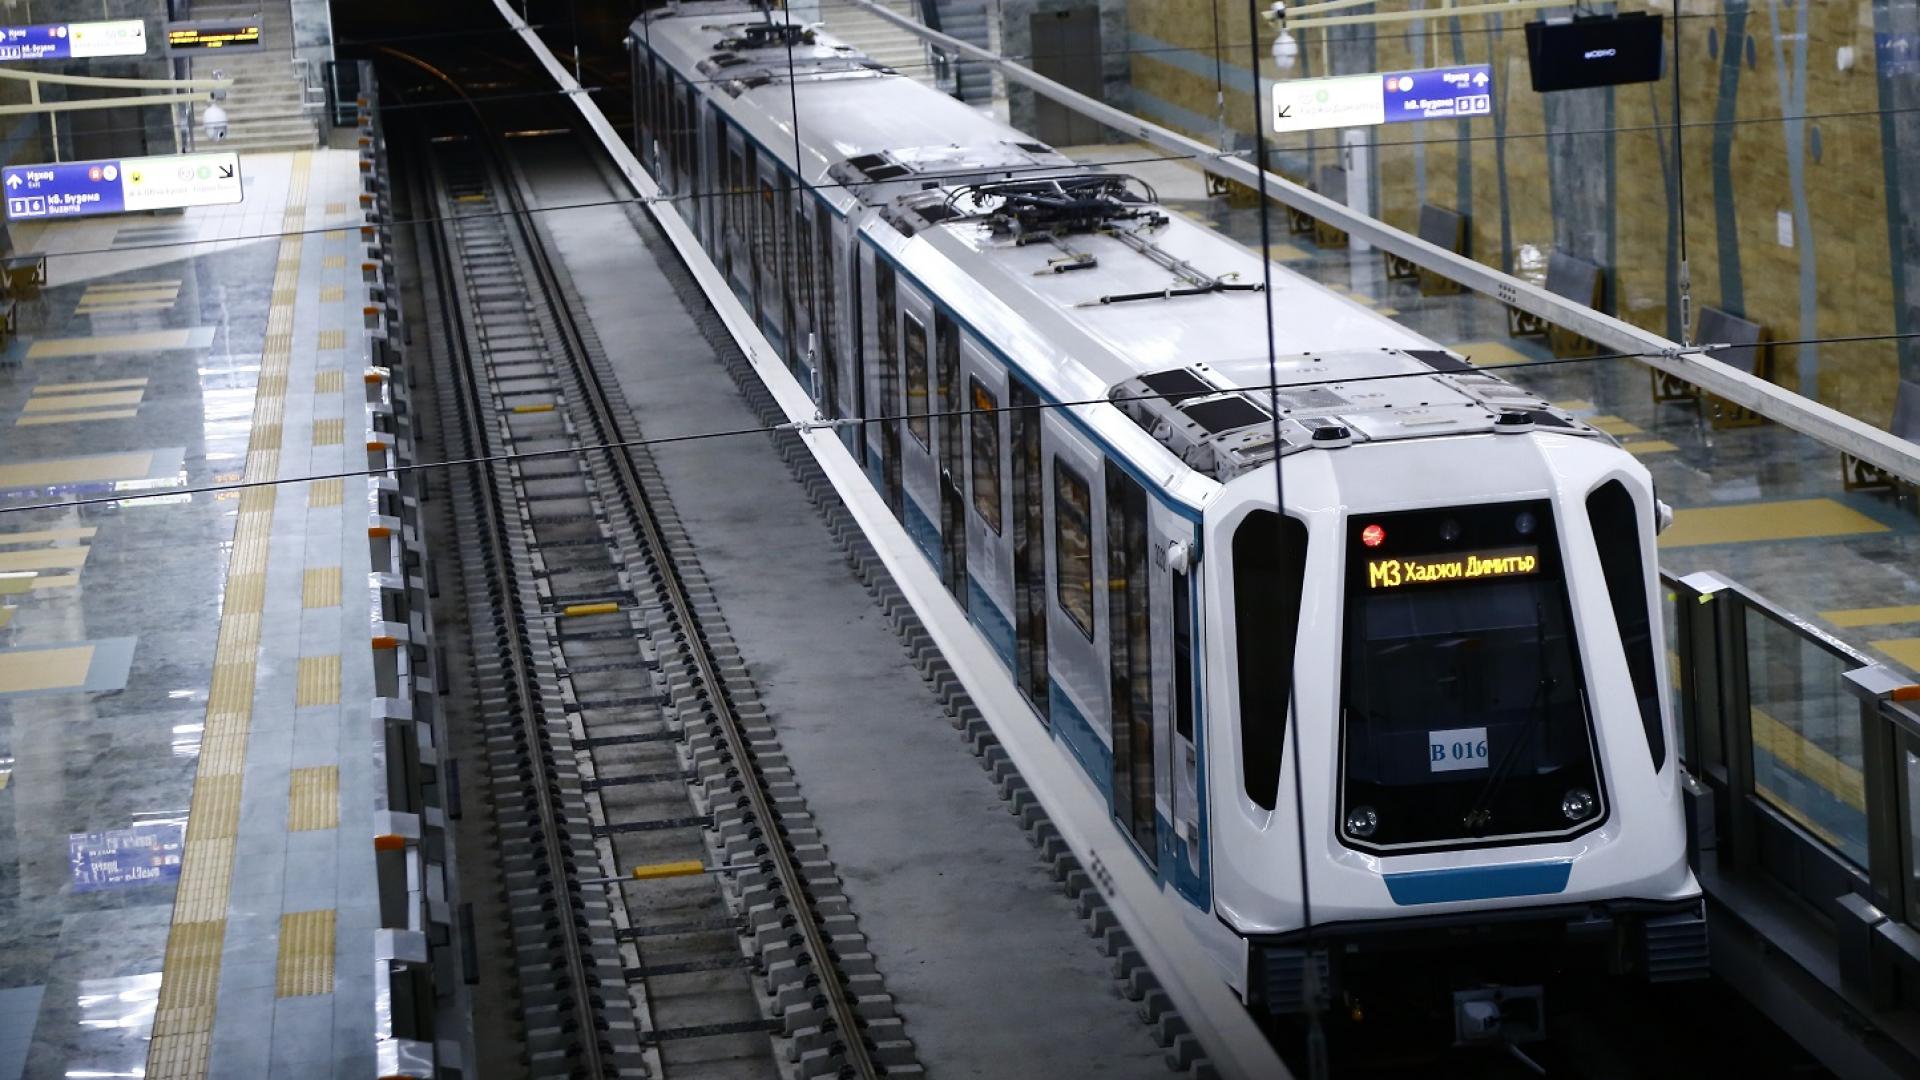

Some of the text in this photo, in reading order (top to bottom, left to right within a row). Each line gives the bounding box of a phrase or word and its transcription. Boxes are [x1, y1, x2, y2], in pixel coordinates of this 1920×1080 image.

[1405, 561, 1462, 582] Хаджи
[1465, 555, 1536, 578] Димитър
[1452, 740, 1488, 761] 016
